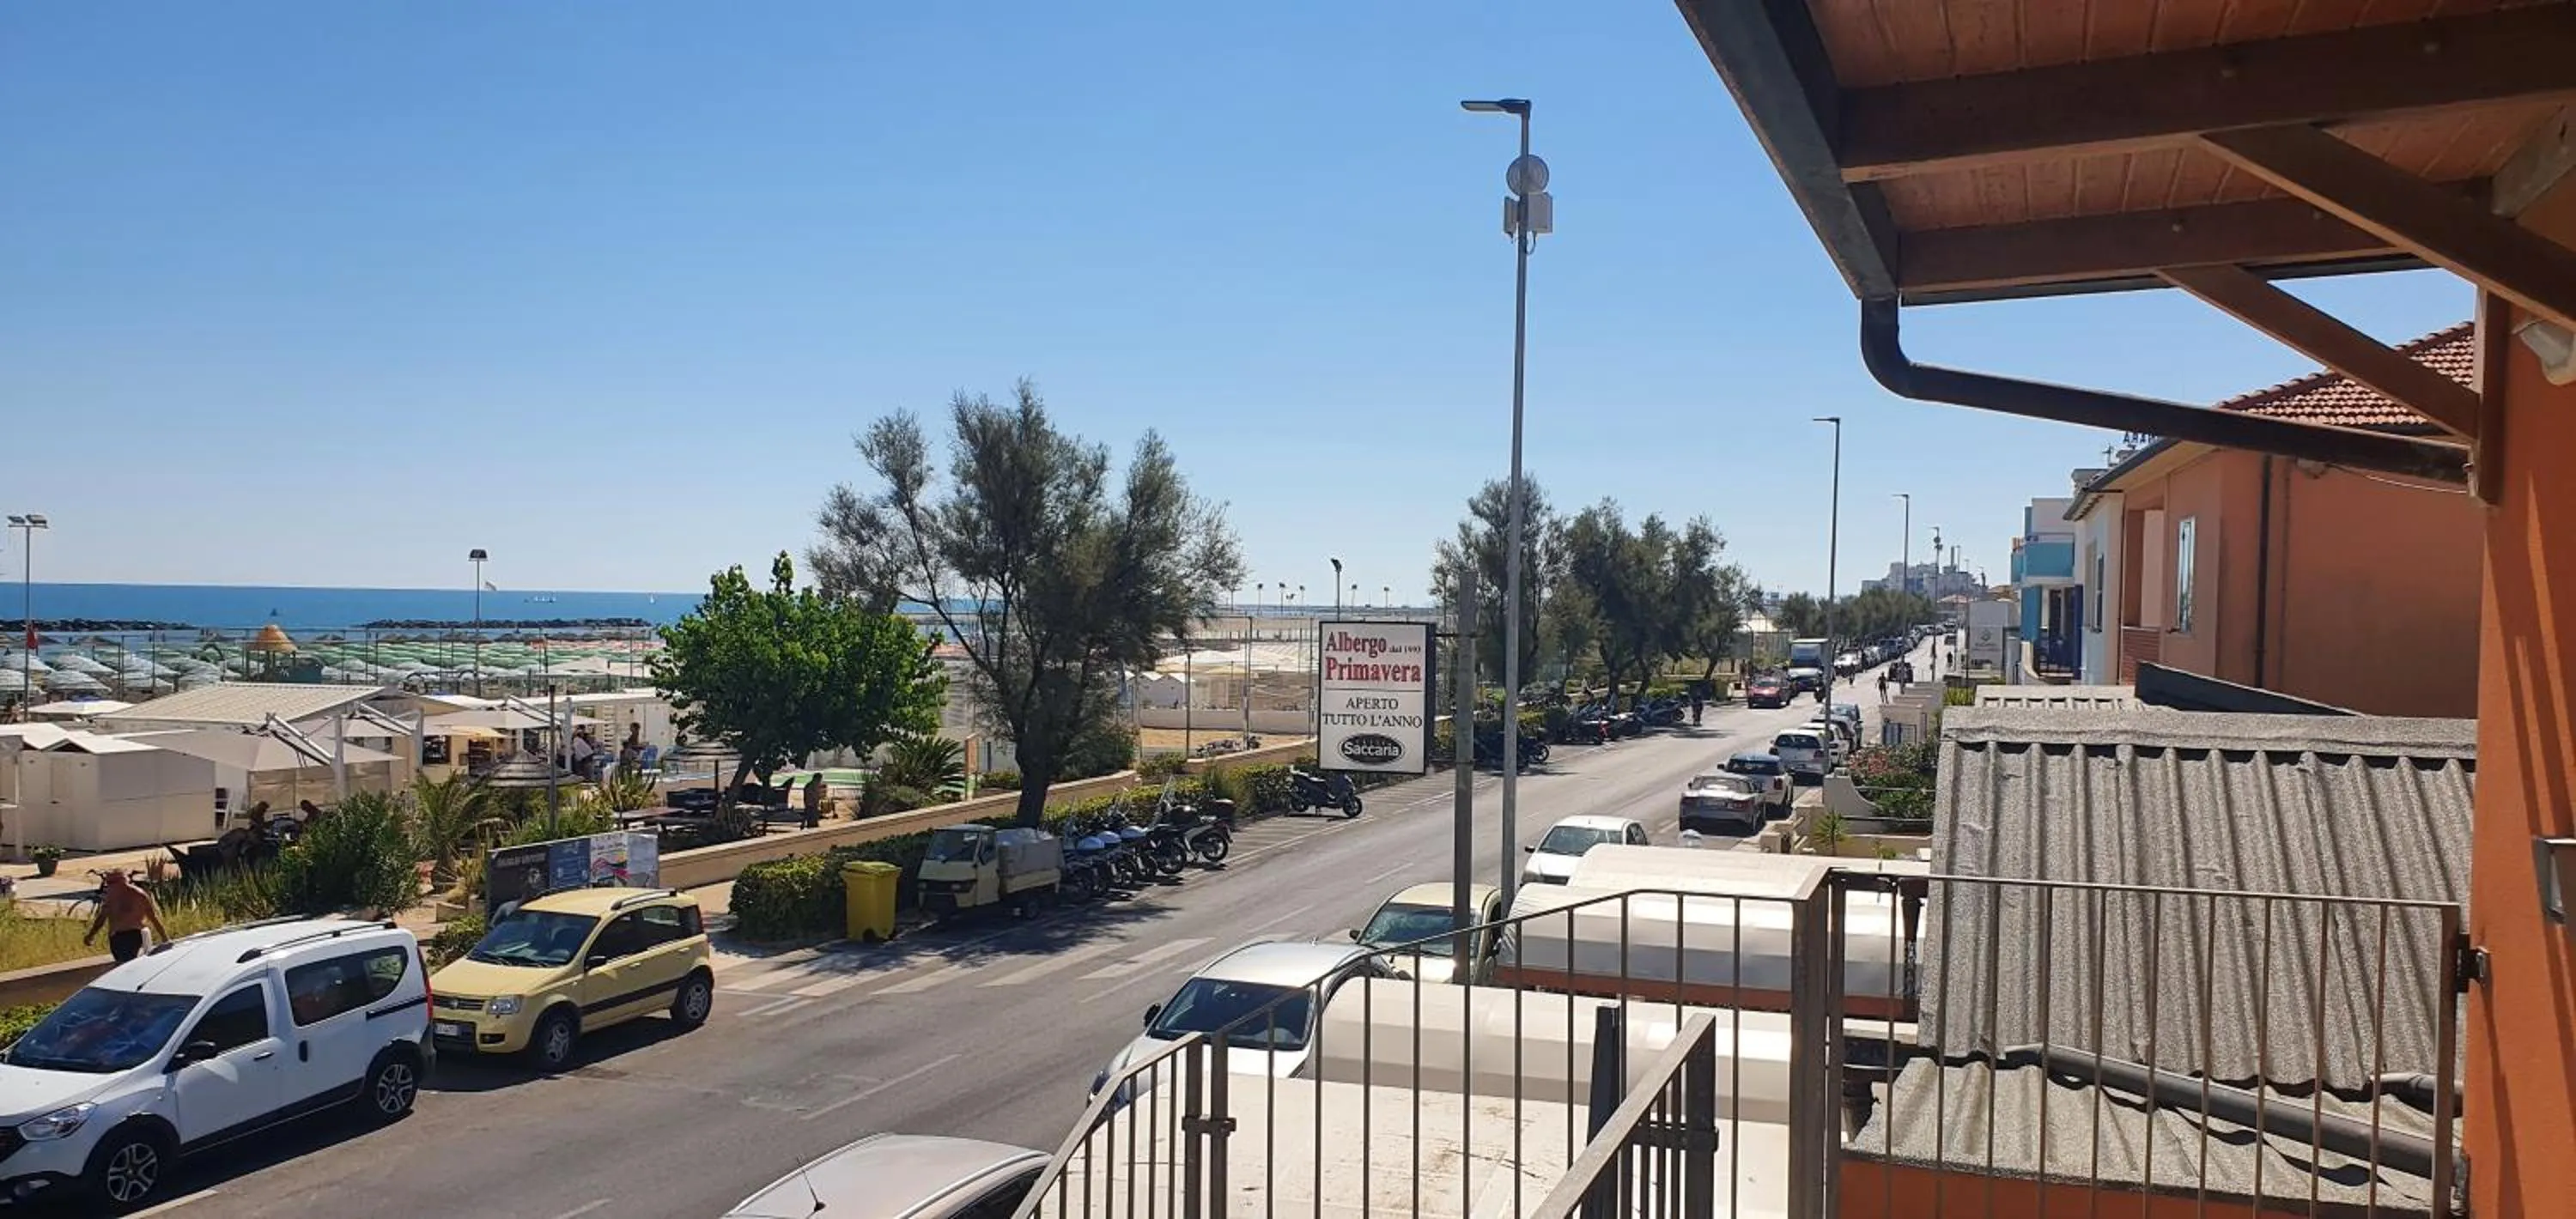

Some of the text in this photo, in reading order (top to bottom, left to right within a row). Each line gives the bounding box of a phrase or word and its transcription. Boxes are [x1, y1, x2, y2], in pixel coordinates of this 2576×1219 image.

[1325, 632, 1387, 658] Albergo
[1325, 657, 1422, 682] Primavera
[1346, 697, 1399, 710] APERTO
[1322, 713, 1423, 728] TUTTO L'ANNO
[1344, 741, 1399, 756] Saccaria
